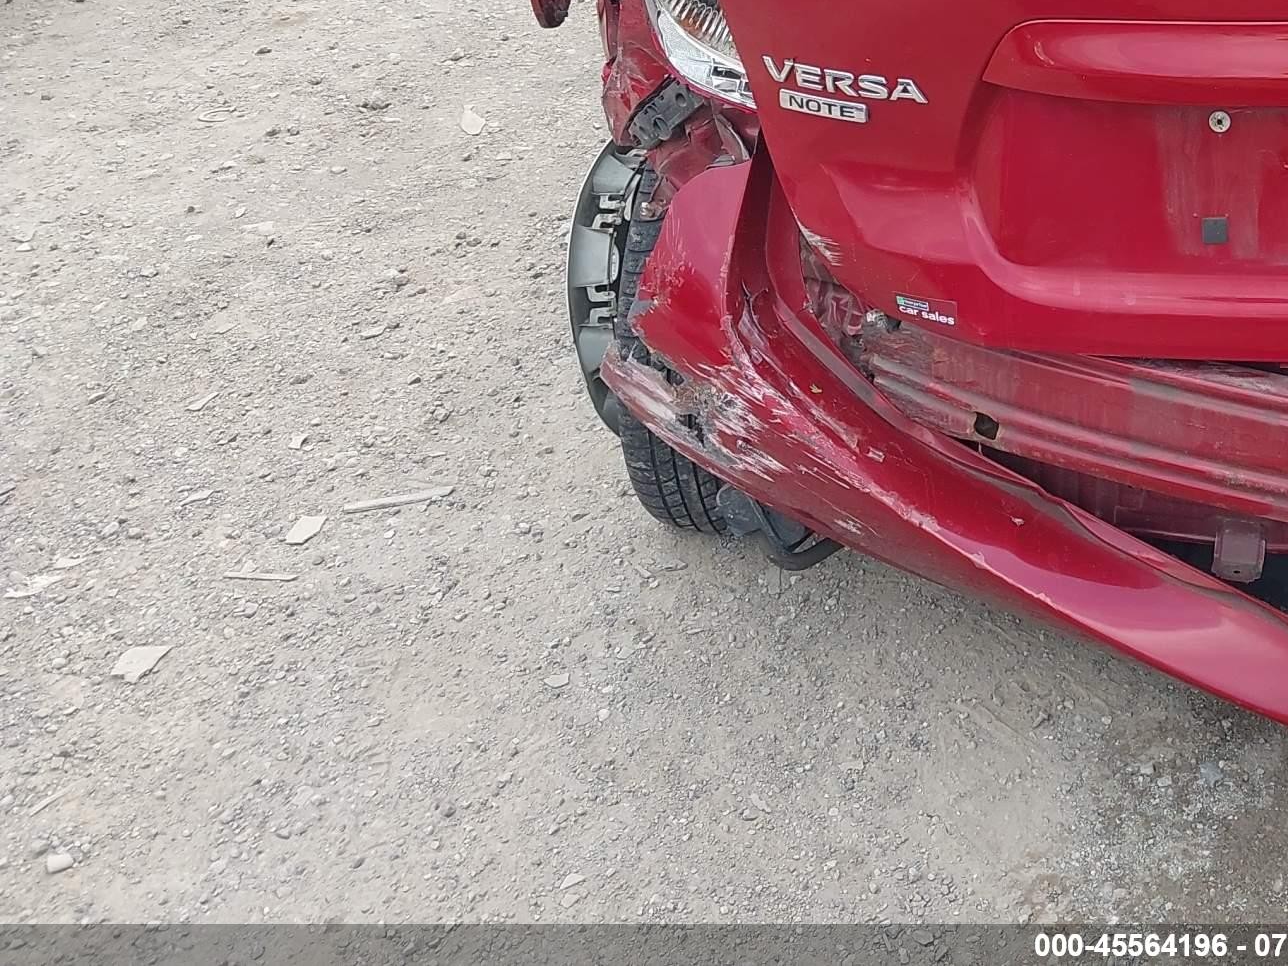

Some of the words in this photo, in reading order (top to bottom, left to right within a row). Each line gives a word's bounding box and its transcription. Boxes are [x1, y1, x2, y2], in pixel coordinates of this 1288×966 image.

[762, 55, 928, 104] VERSA
[789, 95, 857, 119] NOTE
[899, 305, 919, 315] car
[921, 311, 955, 325] sales
